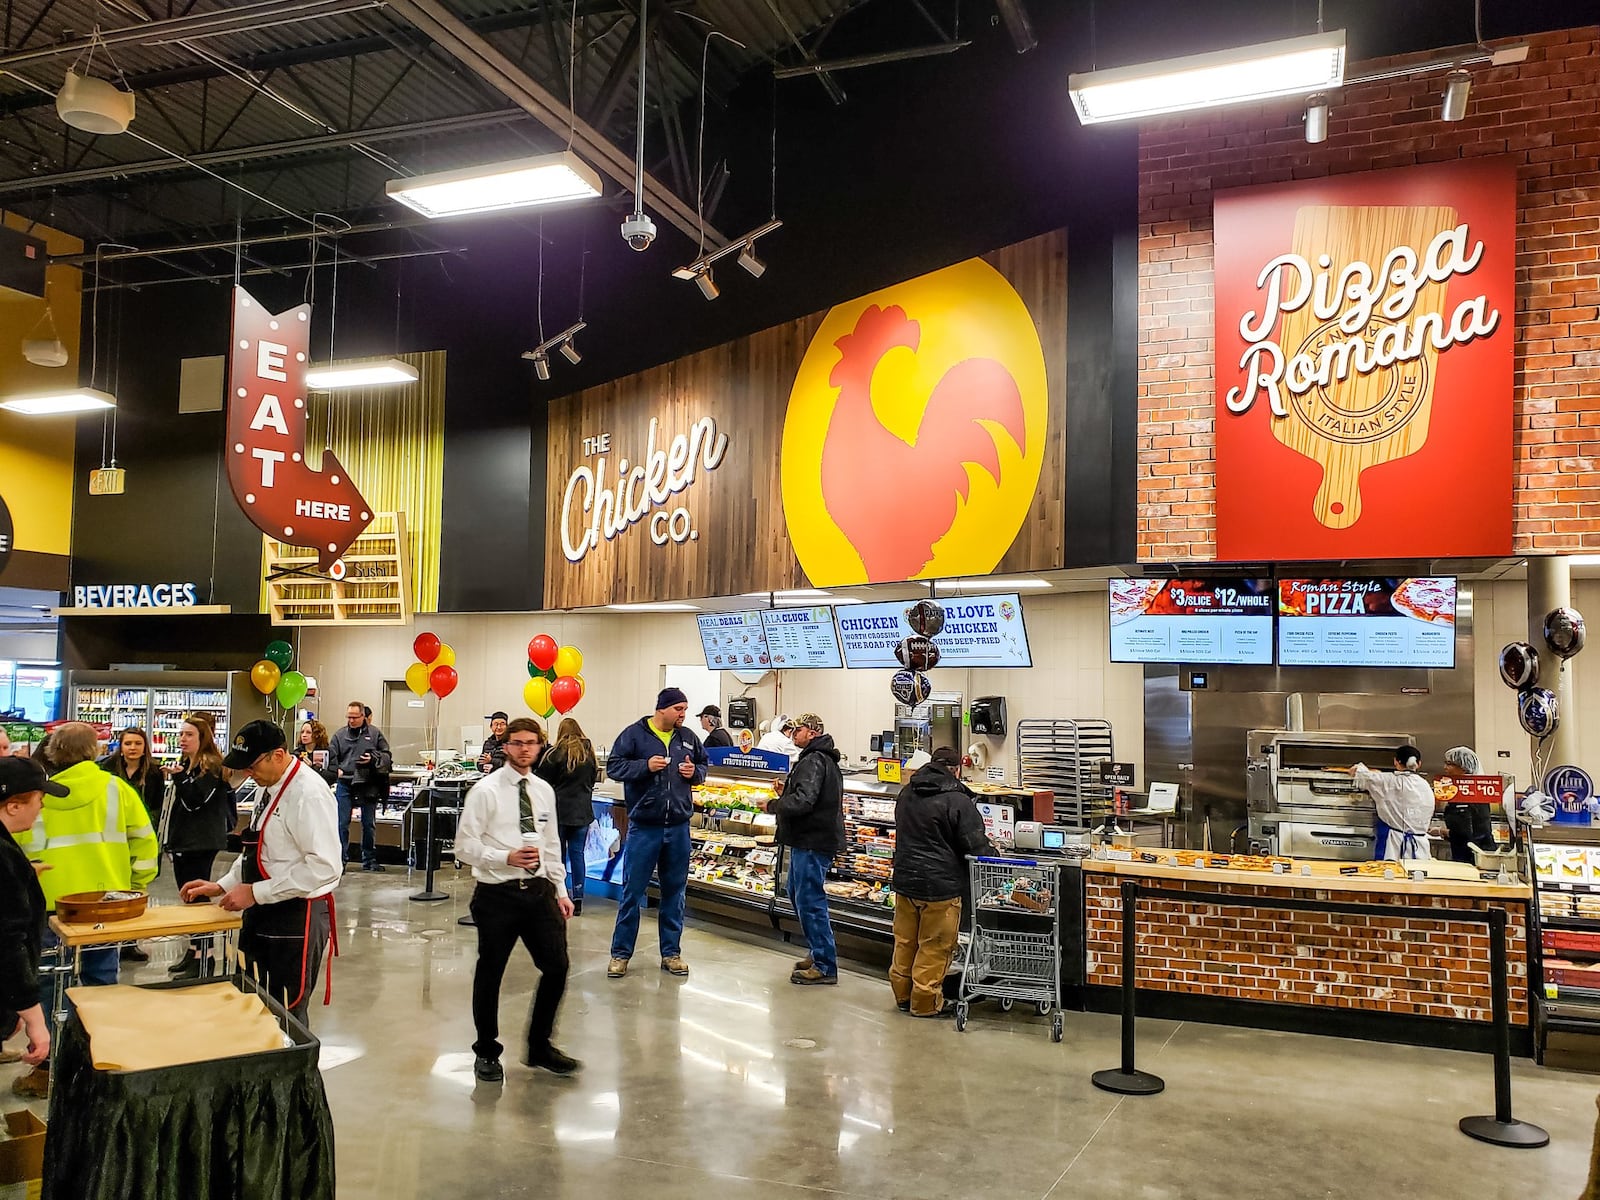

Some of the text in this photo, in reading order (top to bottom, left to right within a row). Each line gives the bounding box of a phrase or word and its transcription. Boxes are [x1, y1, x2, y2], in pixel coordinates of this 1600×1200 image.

[1239, 223, 1484, 343] Pizza
[1226, 295, 1501, 418] Romana
[249, 339, 290, 488] EAT
[1317, 375, 1417, 434] ITALIAN STYLE
[582, 433, 612, 457] THE
[97, 471, 119, 493] EXIT
[561, 416, 729, 563] Chicken
[295, 499, 351, 522] HERE
[650, 507, 700, 546] CO.
[353, 560, 387, 578] Sushi
[74, 582, 197, 608] BEVERAGES
[1290, 580, 1382, 597] Roman Style
[958, 604, 995, 618] LOVE
[1306, 593, 1366, 614] PIZZA
[700, 616, 743, 627] MEAL DEALS
[765, 614, 770, 624] A
[782, 612, 810, 623] CLUCK
[841, 616, 898, 631] CHICKEN
[945, 621, 998, 634] CHICKEN
[844, 631, 900, 641] WORTH CROSSING
[846, 641, 863, 650] THE
[863, 640, 885, 650] ROAD
[954, 636, 1000, 646] DEEP-FRIED
[742, 759, 750, 767] ITS
